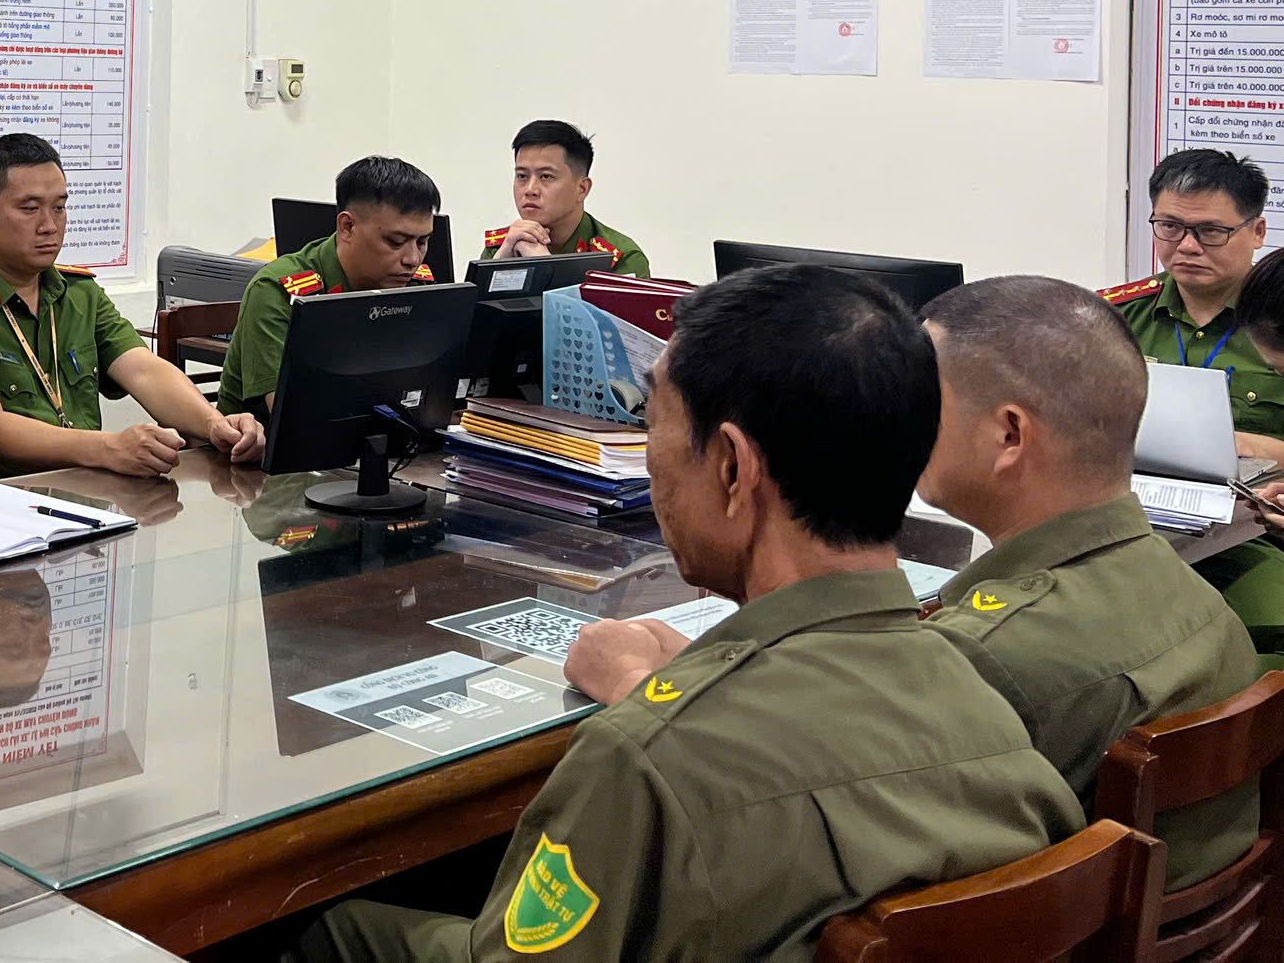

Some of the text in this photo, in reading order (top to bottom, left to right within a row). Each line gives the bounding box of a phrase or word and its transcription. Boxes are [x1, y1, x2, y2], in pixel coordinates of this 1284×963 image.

[1190, 30, 1228, 38] Xe mô tô
[1190, 64, 1200, 73] Trị
[1202, 65, 1215, 74] giá
[1236, 66, 1282, 74] 15.000.000
[380, 306, 413, 316] Gateway
